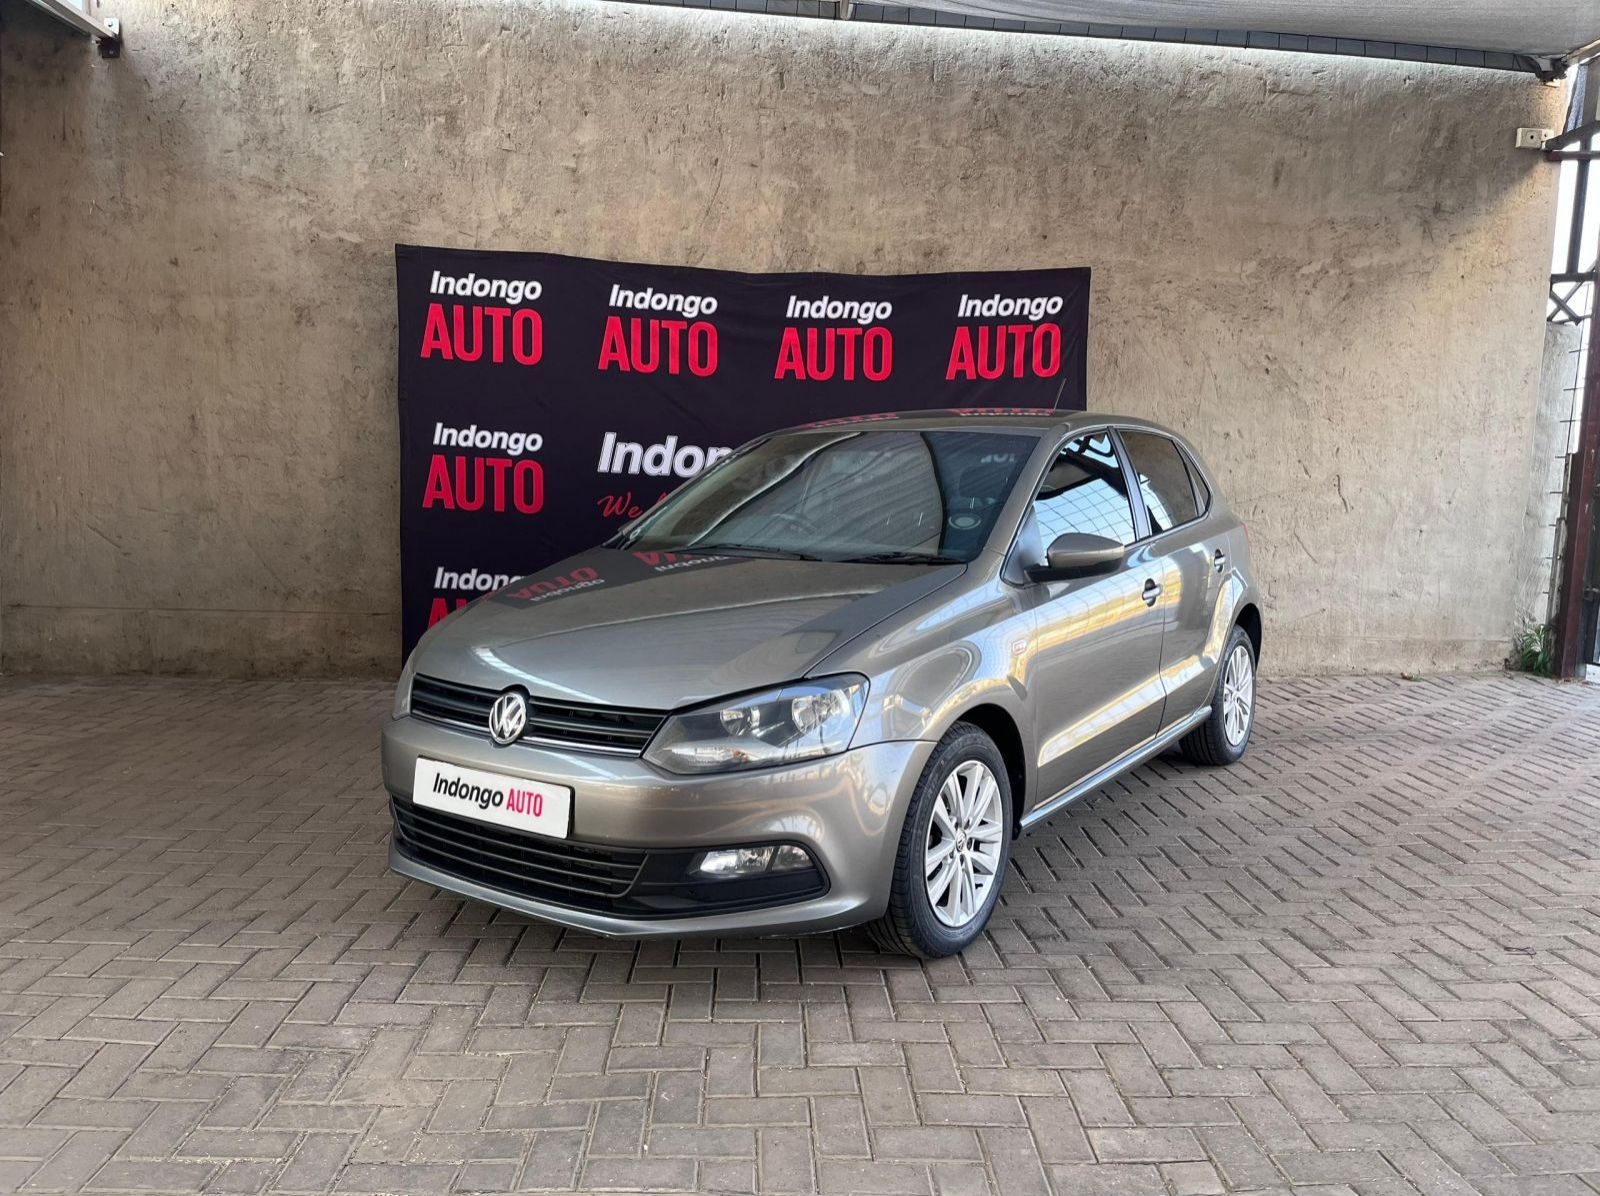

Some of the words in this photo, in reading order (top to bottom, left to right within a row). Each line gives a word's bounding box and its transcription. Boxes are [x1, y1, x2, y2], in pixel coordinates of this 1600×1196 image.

[430, 270, 543, 305] Indongo
[609, 284, 718, 319] Indongo
[786, 295, 893, 325] Indongo
[957, 294, 1064, 322] Indongo
[420, 303, 544, 367] AUTO
[598, 316, 719, 378] AUTO
[774, 326, 894, 382] AUTO
[945, 323, 1062, 381] AUTO
[433, 422, 543, 456] Indongo
[422, 454, 545, 515] AUTO
[597, 491, 643, 519] We
[432, 772, 504, 810] Indongo
[506, 788, 544, 818] AUTO
